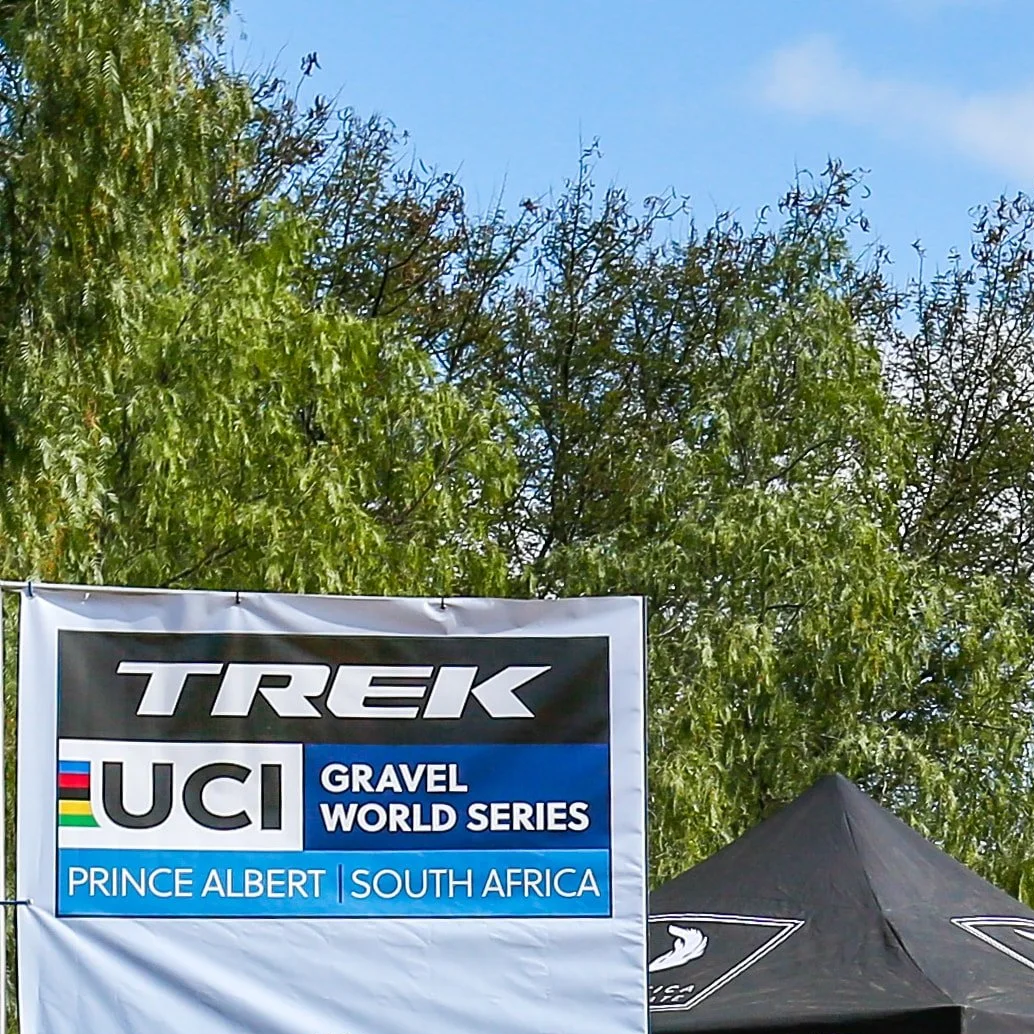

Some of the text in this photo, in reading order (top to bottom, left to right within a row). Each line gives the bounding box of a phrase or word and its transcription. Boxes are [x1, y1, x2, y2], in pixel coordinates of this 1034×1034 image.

[116, 661, 552, 719] TREK
[320, 762, 468, 794] GRAVEL
[102, 761, 282, 830] UCI
[319, 802, 590, 832] WORLD SERIES
[68, 867, 601, 899] PRINCE ALBERT SOUTH AFRICA
